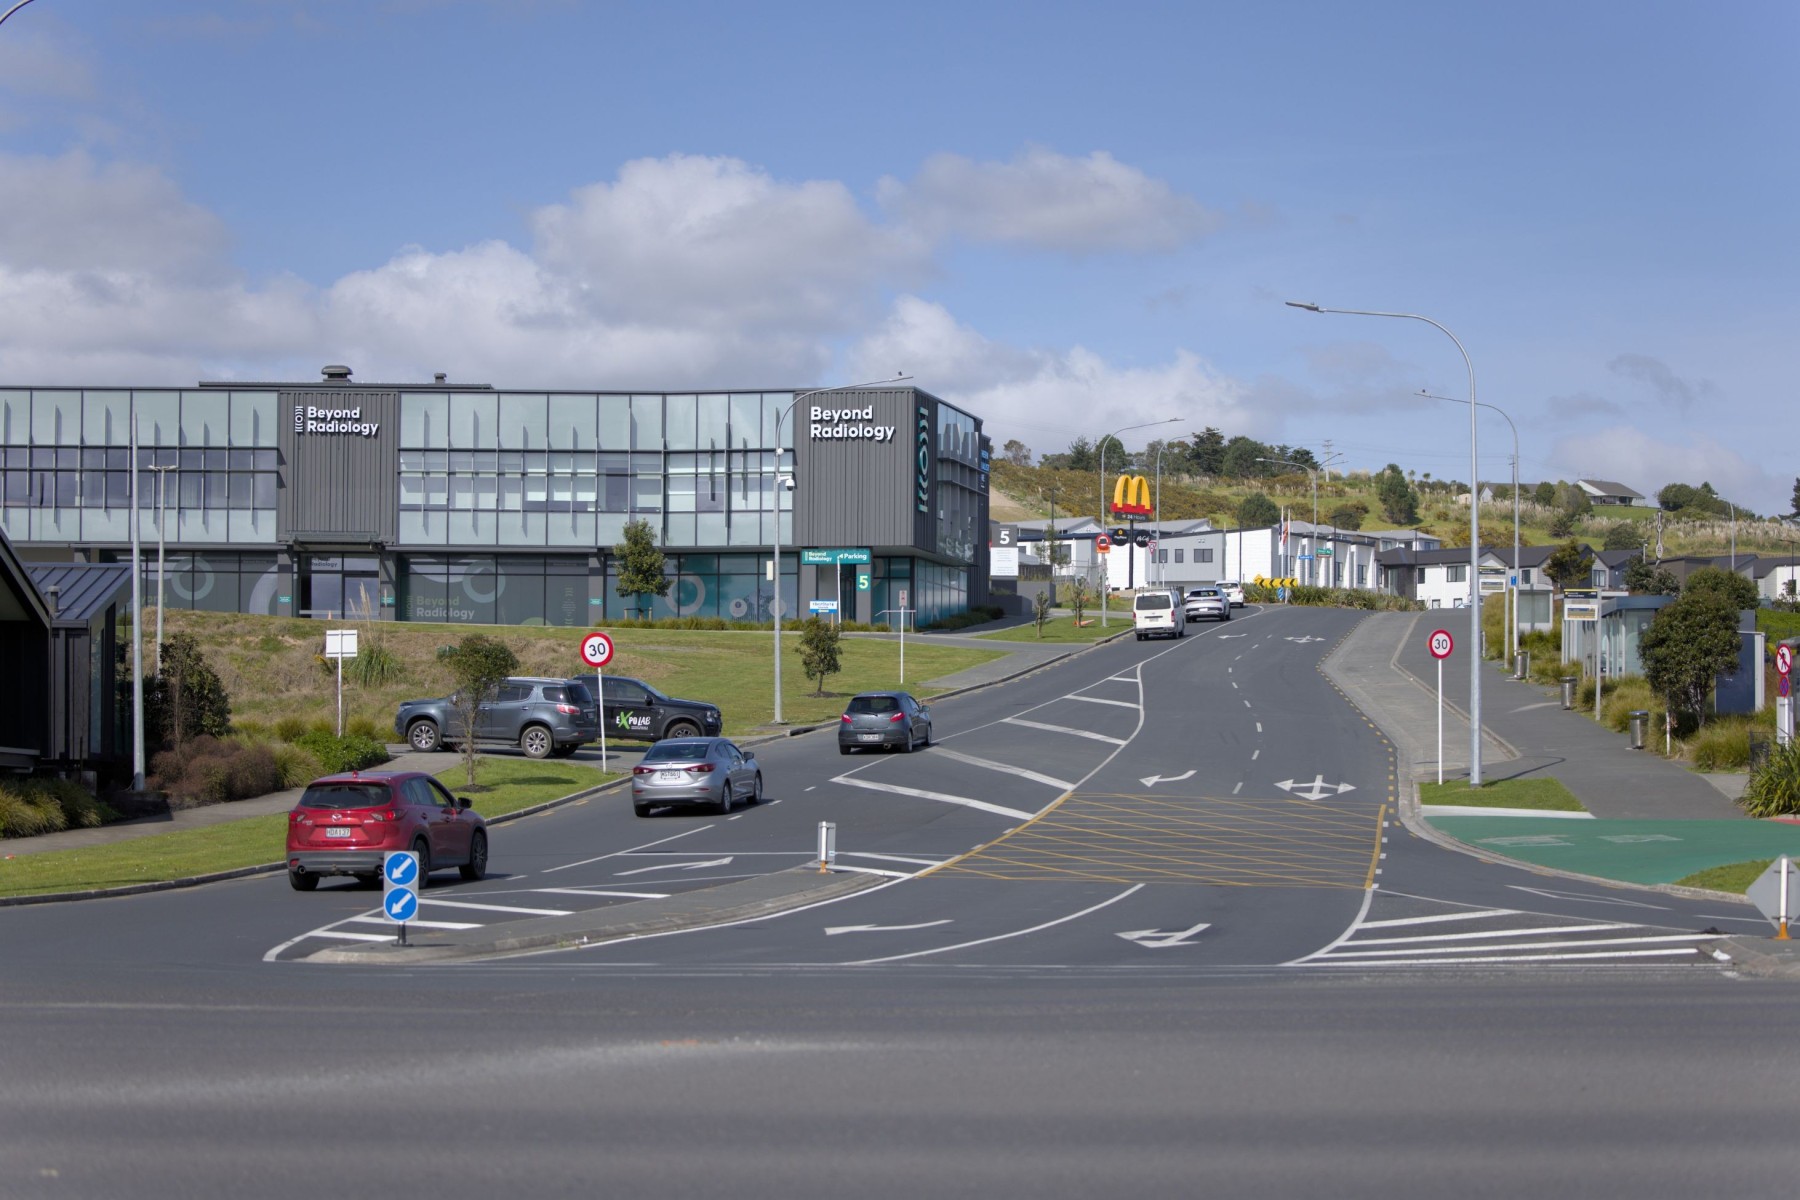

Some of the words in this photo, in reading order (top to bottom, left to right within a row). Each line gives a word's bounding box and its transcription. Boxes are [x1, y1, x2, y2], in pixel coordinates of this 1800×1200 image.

[307, 406, 360, 421] Beyond
[811, 405, 873, 424] Beyond
[307, 421, 378, 436] Radiology
[811, 423, 895, 441] Radiology
[1000, 530, 1010, 545] 5
[859, 575, 869, 589] 5
[589, 642, 606, 657] 30
[1434, 638, 1448, 650] 30
